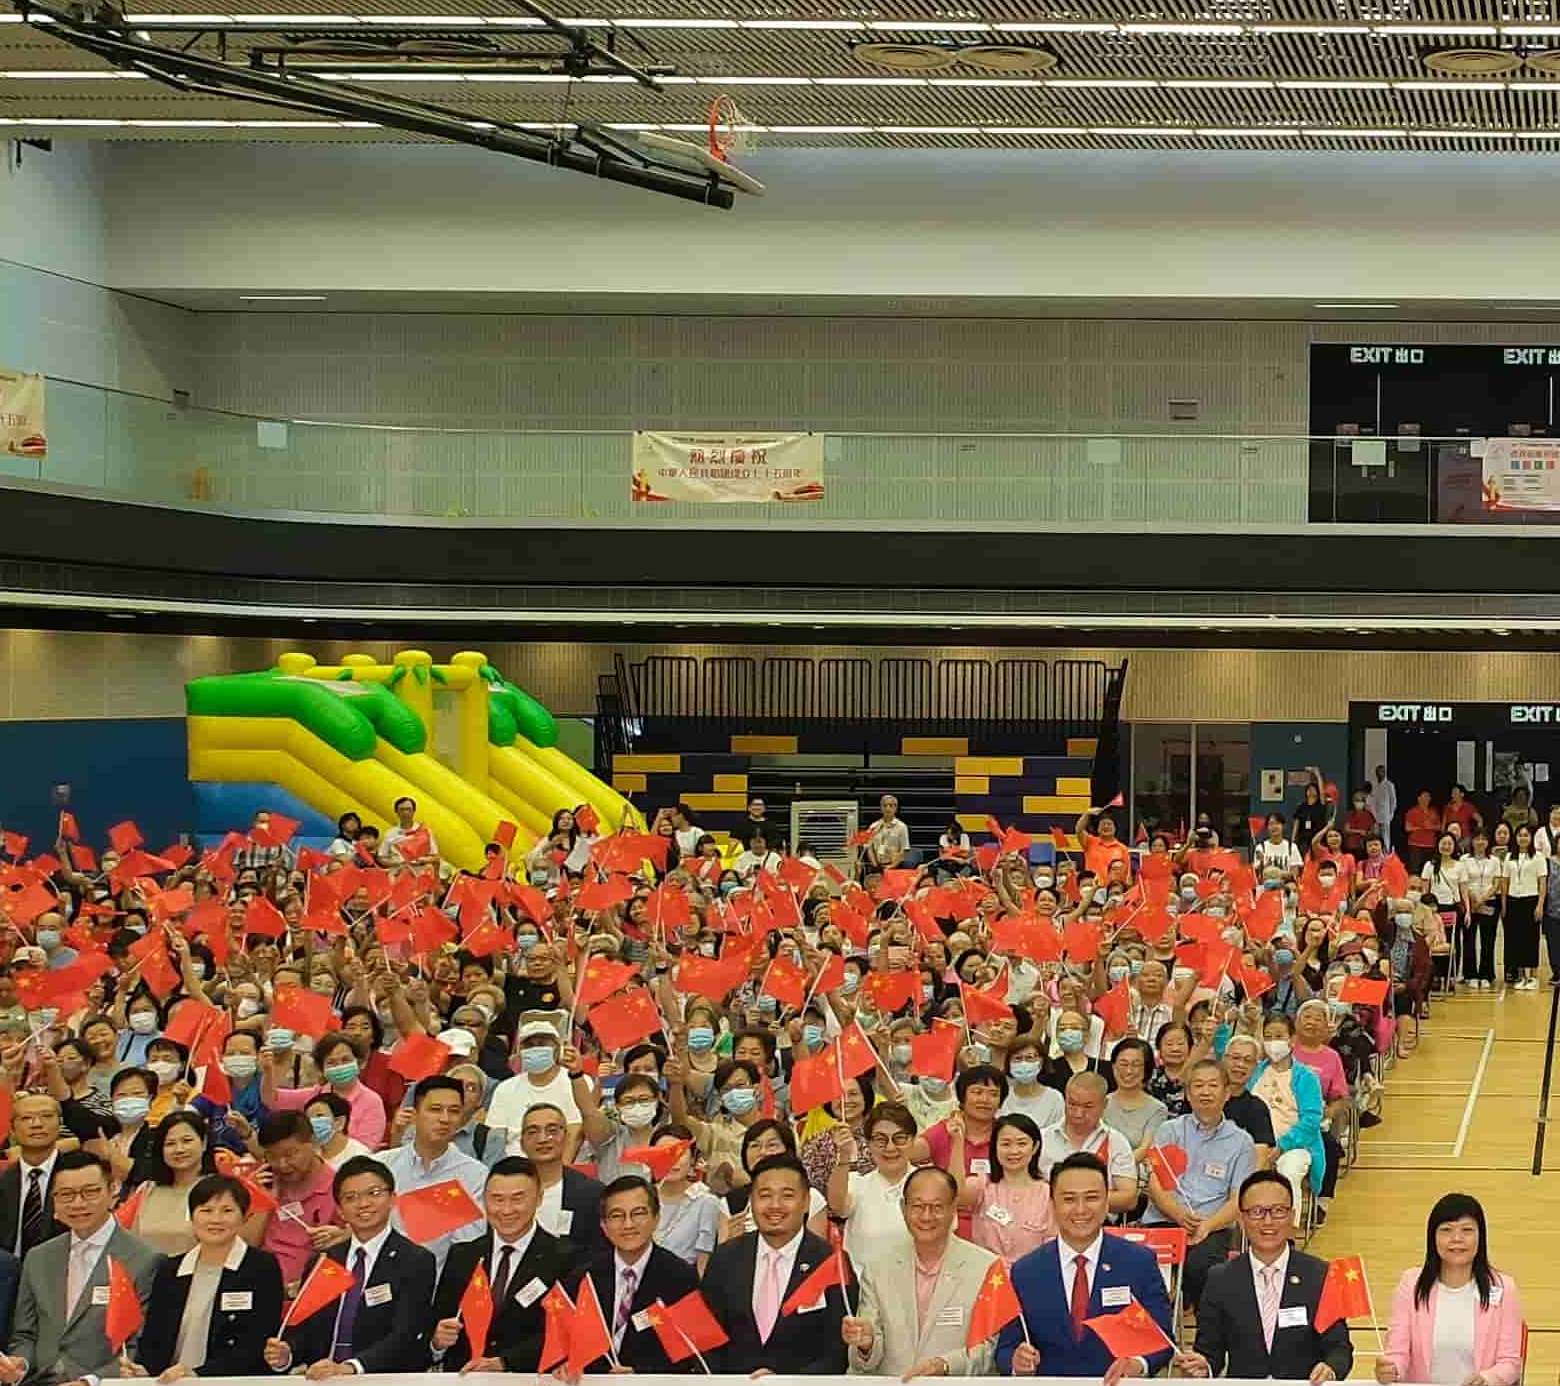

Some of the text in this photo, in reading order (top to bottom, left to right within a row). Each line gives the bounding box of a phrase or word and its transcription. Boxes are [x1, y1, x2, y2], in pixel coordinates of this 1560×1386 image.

[1350, 347, 1424, 363] EXIT 出口
[1504, 348, 1545, 365] EXIT
[1378, 705, 1452, 722] EXIT 出口
[1511, 706, 1553, 722] EXIT
